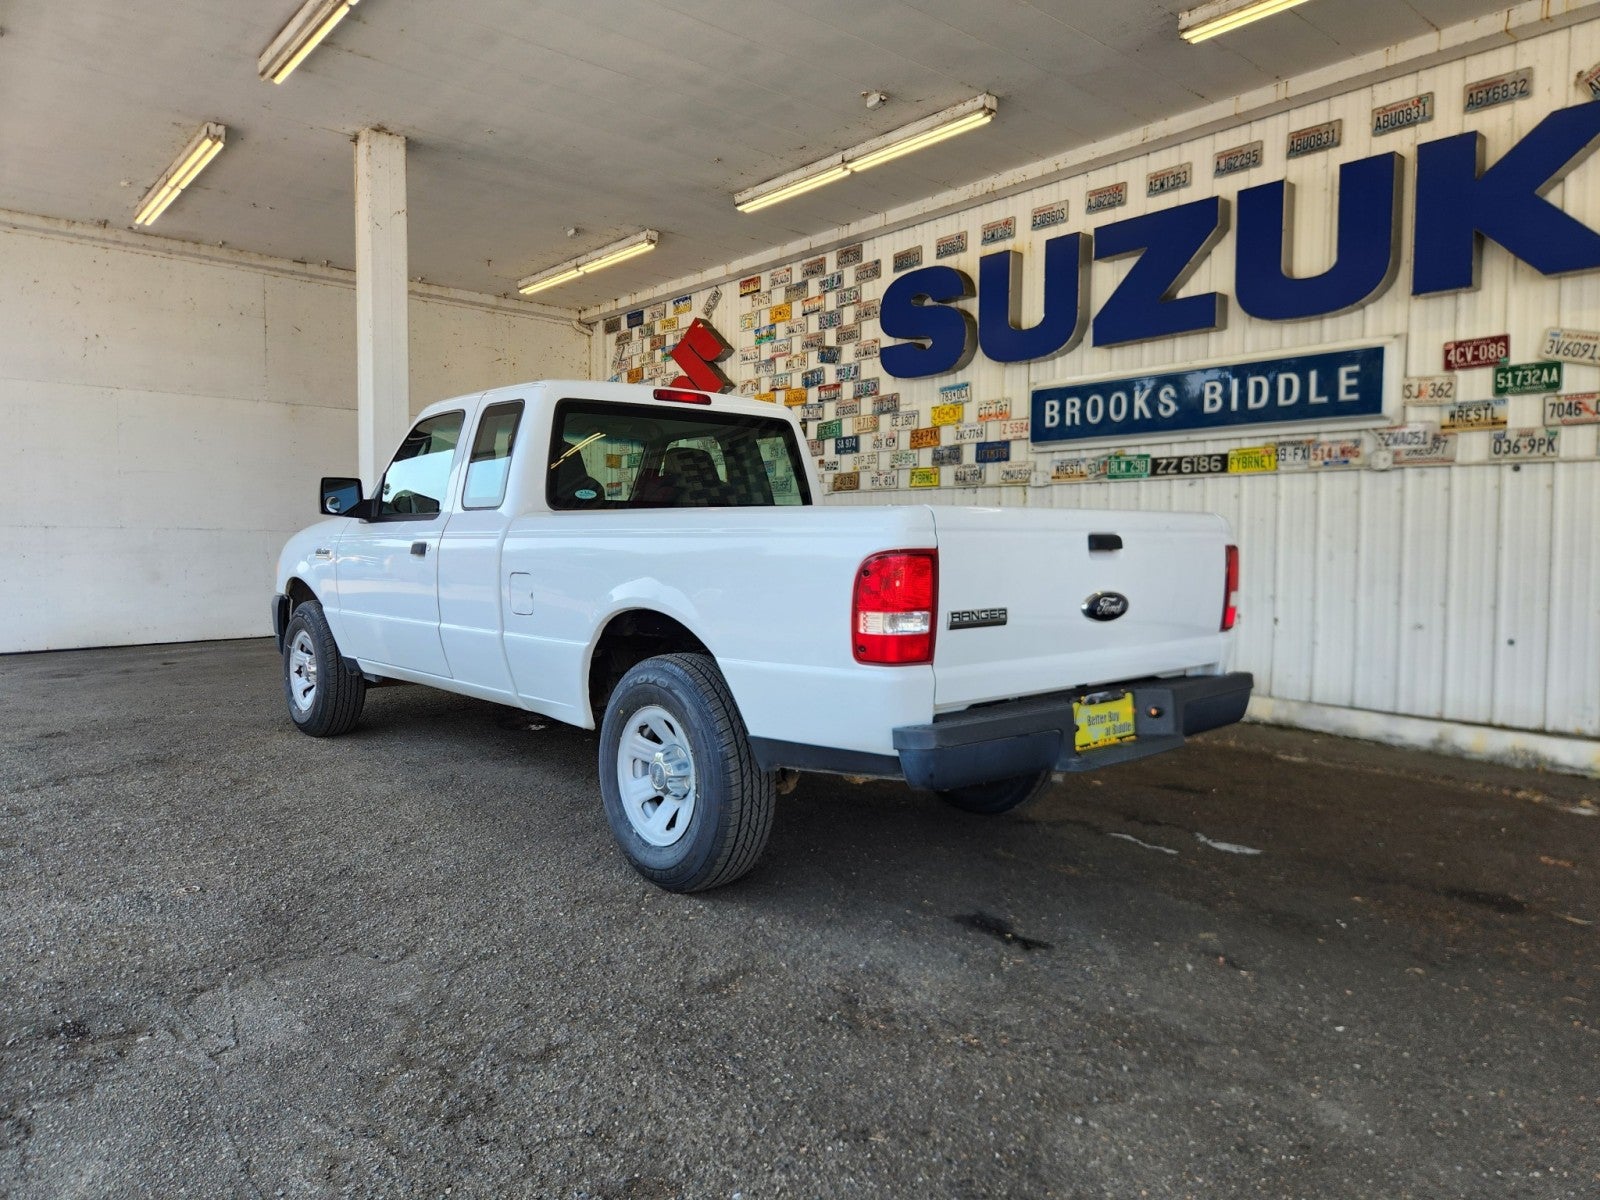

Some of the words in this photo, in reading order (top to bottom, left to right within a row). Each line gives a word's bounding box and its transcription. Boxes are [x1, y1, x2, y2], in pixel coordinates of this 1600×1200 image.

[1375, 103, 1426, 131] ABU0831
[1545, 339, 1600, 362] 3V6091
[1044, 383, 1178, 429] BROOKS
[1203, 363, 1361, 415] BIDDLE
[845, 438, 856, 448] 974
[1157, 459, 1178, 475] ZZ
[1181, 456, 1222, 474] 6186
[950, 607, 1007, 622] RANGER
[1096, 596, 1123, 615] Ford
